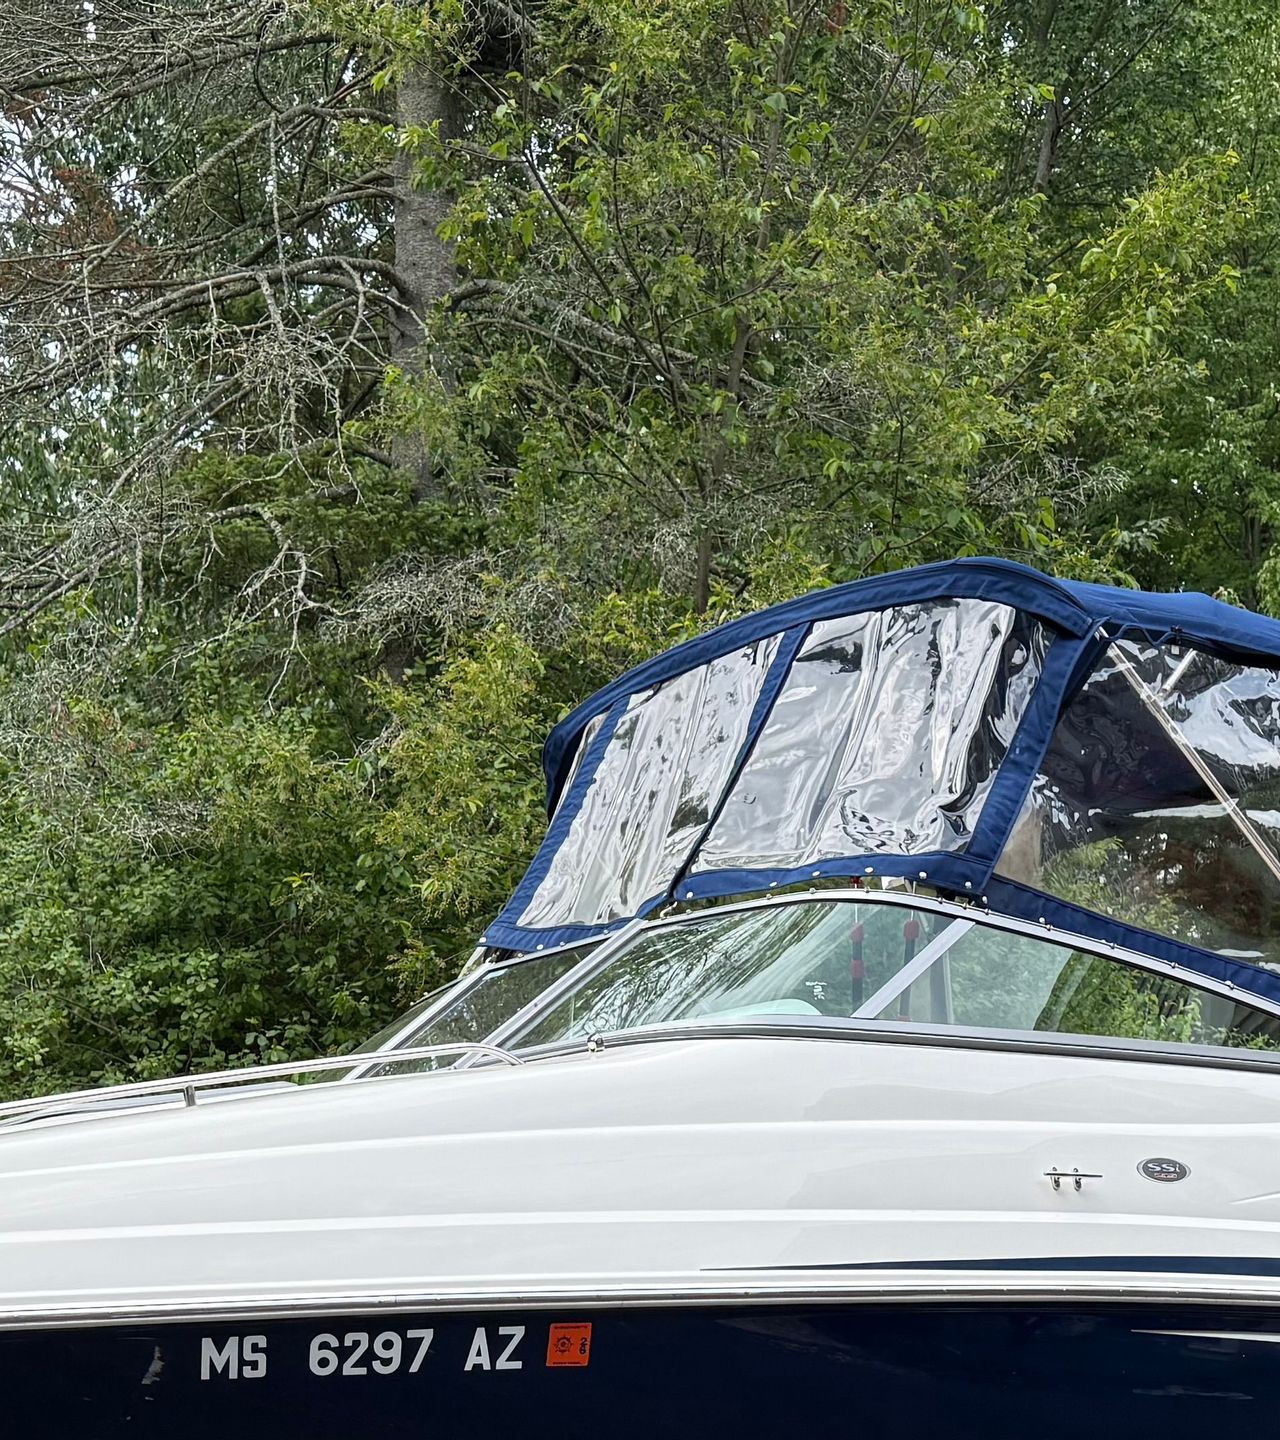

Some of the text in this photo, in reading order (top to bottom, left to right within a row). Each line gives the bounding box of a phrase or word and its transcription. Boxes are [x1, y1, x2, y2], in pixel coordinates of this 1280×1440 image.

[200, 1325, 526, 1381] MS 6297 AZ
